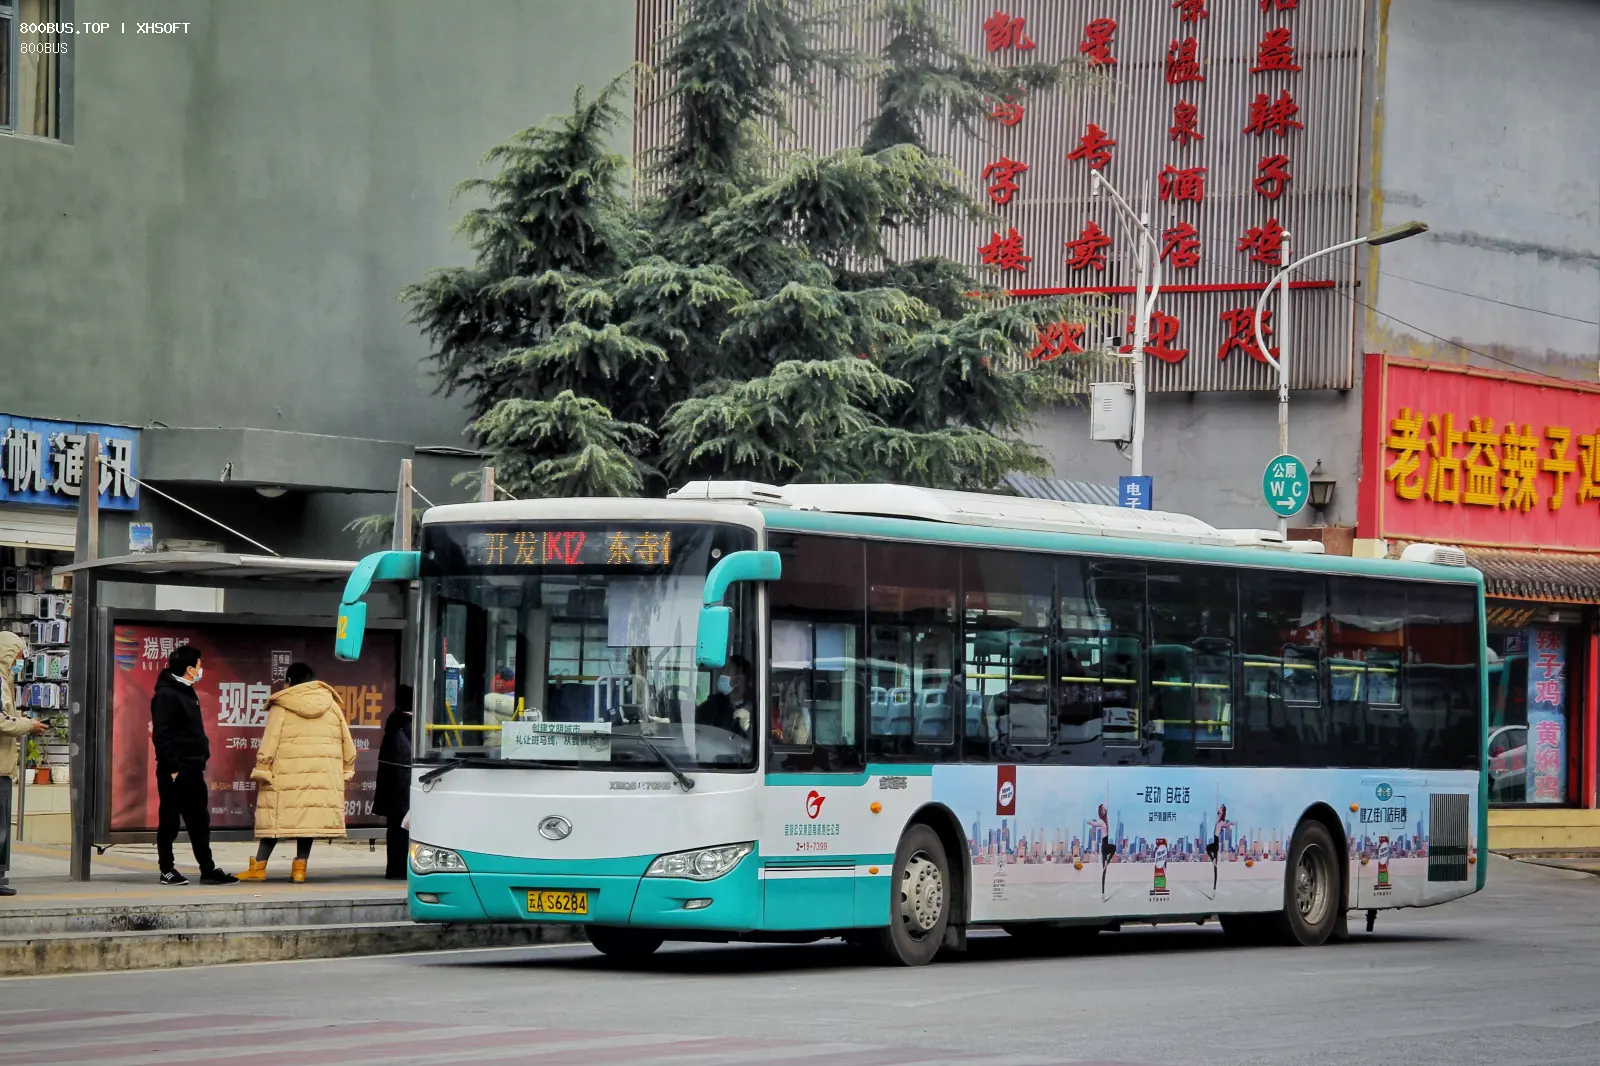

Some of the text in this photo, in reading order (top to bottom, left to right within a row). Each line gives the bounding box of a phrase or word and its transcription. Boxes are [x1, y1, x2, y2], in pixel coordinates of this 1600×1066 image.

[1236, 0, 1304, 266] 益辣子鸡
[1273, 463, 1297, 478] 公厕
[1535, 630, 1561, 706] 辣子鸡
[218, 681, 271, 726] 现房
[532, 723, 581, 733] 创建文明城市
[225, 737, 247, 749] 二环内
[1136, 786, 1190, 804] 一起动 自在活
